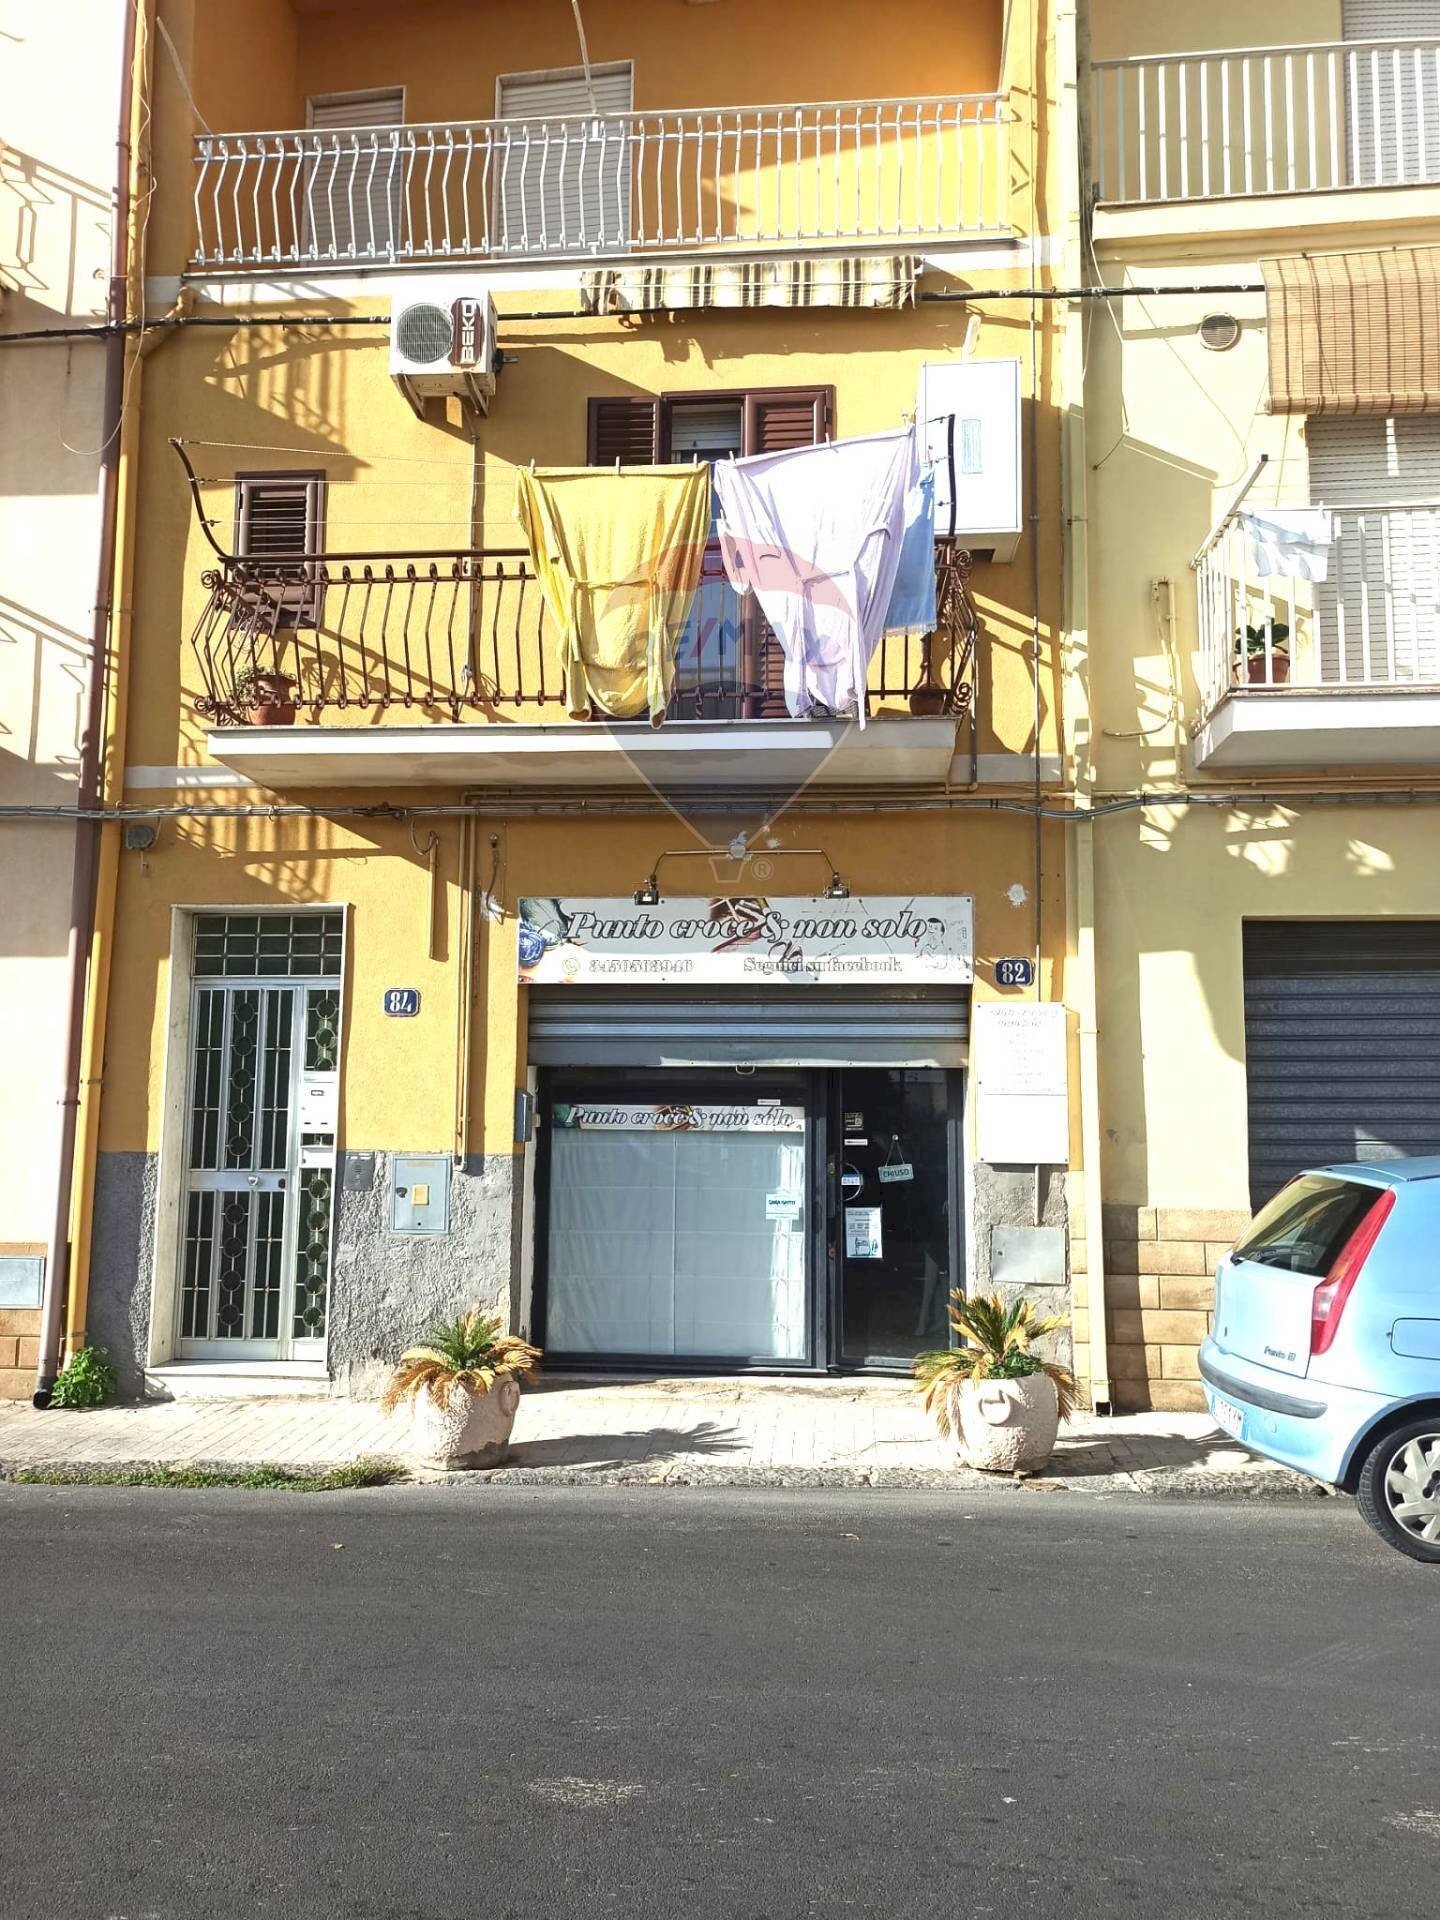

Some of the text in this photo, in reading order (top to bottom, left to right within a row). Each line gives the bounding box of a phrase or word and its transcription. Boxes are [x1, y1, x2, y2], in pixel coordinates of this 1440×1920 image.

[461, 299, 475, 365] BEKO
[563, 911, 664, 939] Punto
[669, 918, 755, 939] croce
[761, 911, 790, 943] &
[793, 918, 858, 939] non
[862, 911, 928, 939] solo
[1001, 962, 1026, 984] 82
[390, 991, 412, 1012] 84
[566, 1105, 796, 1129] Punto croce & non solo
[882, 1168, 910, 1178] CHIUSO
